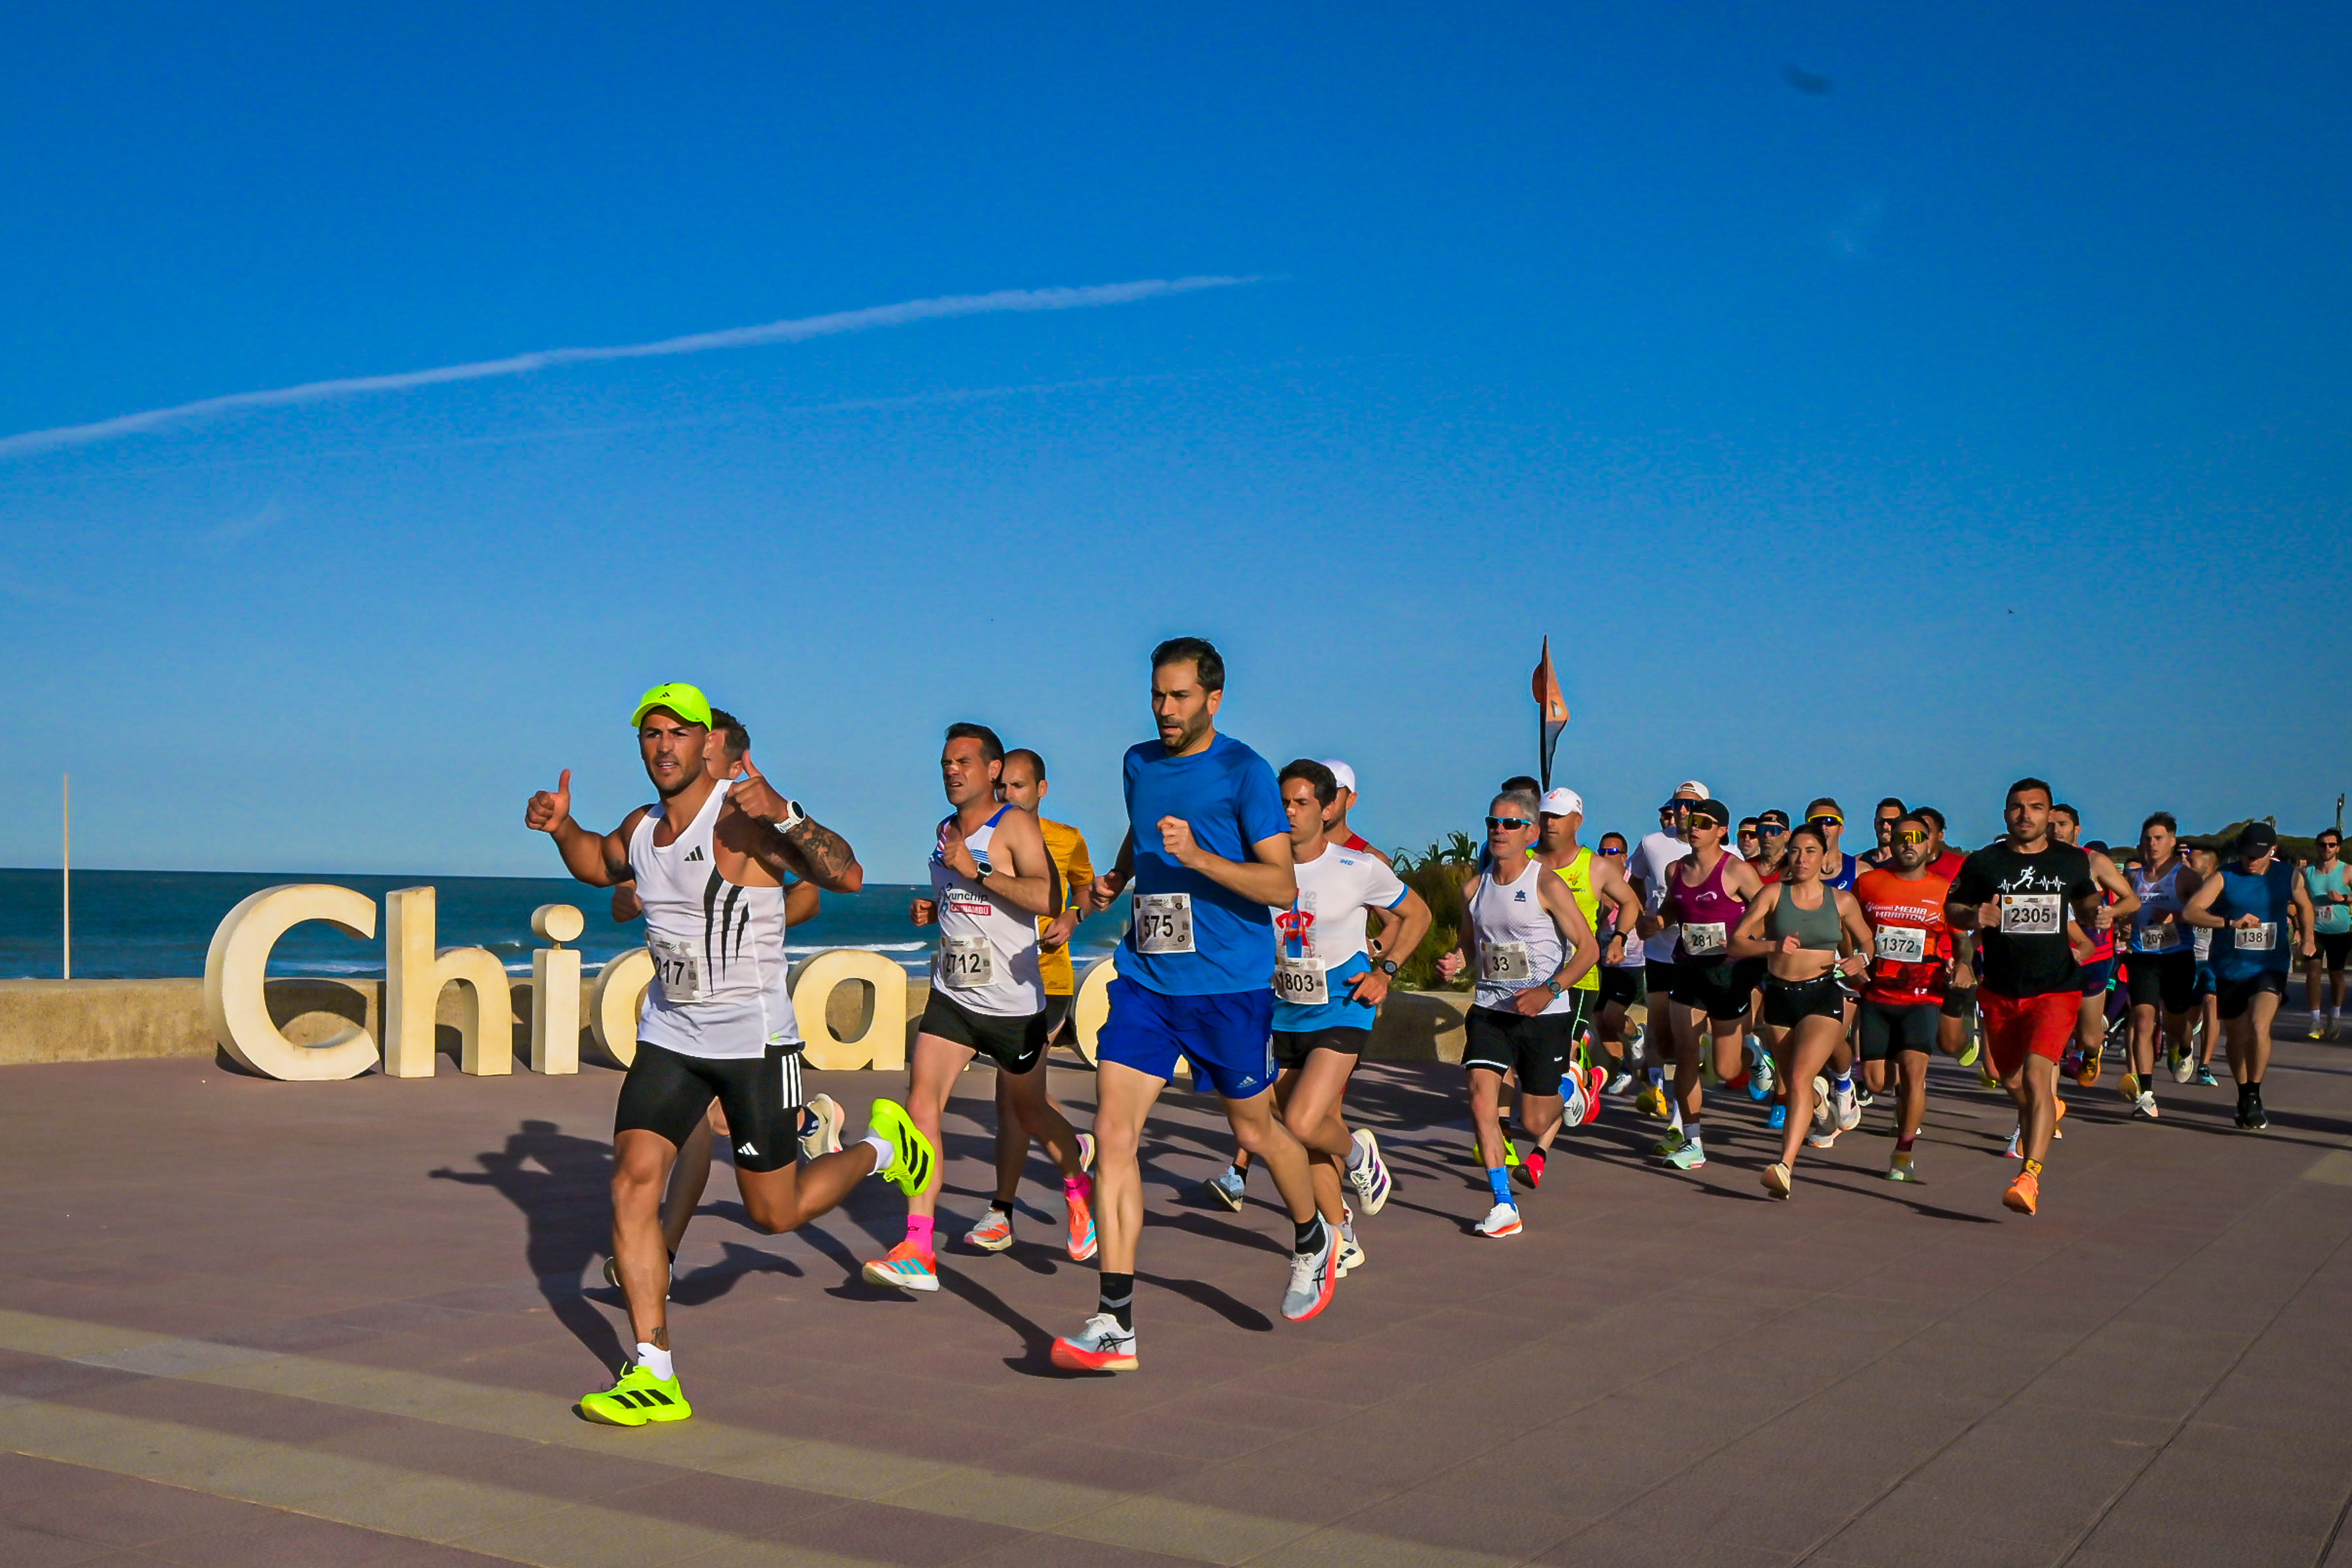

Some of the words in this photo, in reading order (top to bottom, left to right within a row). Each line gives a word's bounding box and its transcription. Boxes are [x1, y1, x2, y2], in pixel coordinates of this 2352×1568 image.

[1893, 905, 1927, 915] MEDIA
[2011, 907, 2050, 923] 2305
[1144, 915, 1173, 937] 575
[1692, 934, 1712, 947] 281
[1882, 937, 1915, 953] 1372
[2242, 931, 2269, 943] 1381
[946, 953, 981, 974] 2712
[1492, 956, 1509, 972] 33
[1278, 971, 1315, 992] 1803
